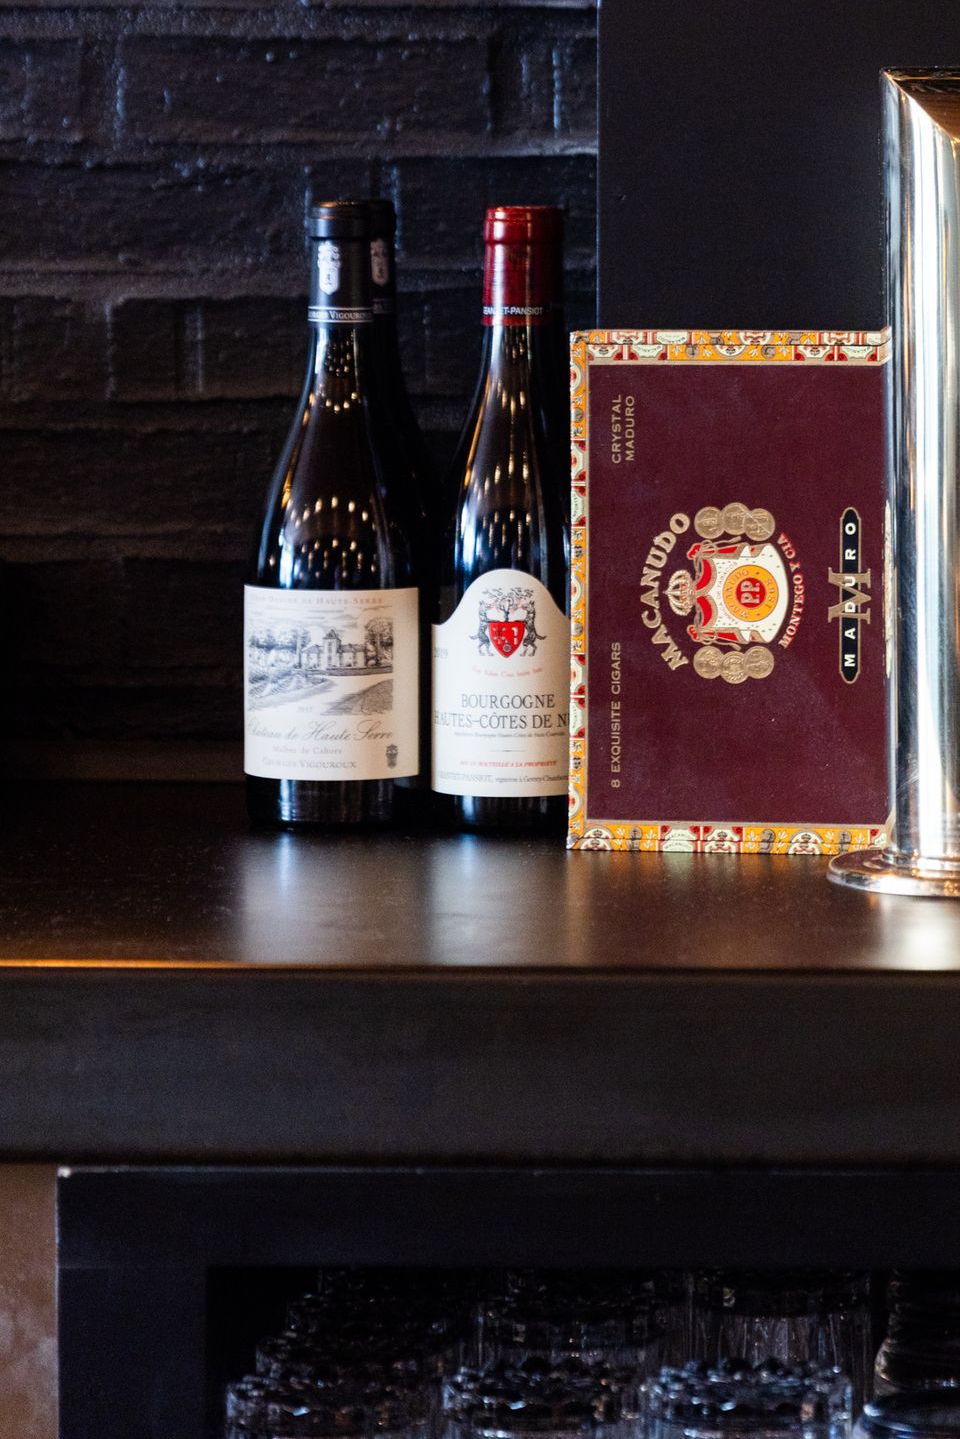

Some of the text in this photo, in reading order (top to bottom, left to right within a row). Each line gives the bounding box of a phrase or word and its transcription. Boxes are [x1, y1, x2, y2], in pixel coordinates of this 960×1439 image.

[611, 394, 622, 464] CRYSTAL
[625, 395, 635, 461] MADURO
[640, 512, 691, 671] MACANUDO
[725, 569, 749, 618] MACANUDO
[765, 578, 775, 609] 1868
[776, 531, 805, 649] MONTEGO Y CIA
[844, 522, 857, 667] MADURO
[461, 693, 556, 710] BOURGOGNE
[532, 714, 552, 729] DE
[611, 642, 621, 788] 8 EXQUISITE CIGARS
[287, 726, 299, 739] de
[300, 758, 357, 769] VIGOUROUX
